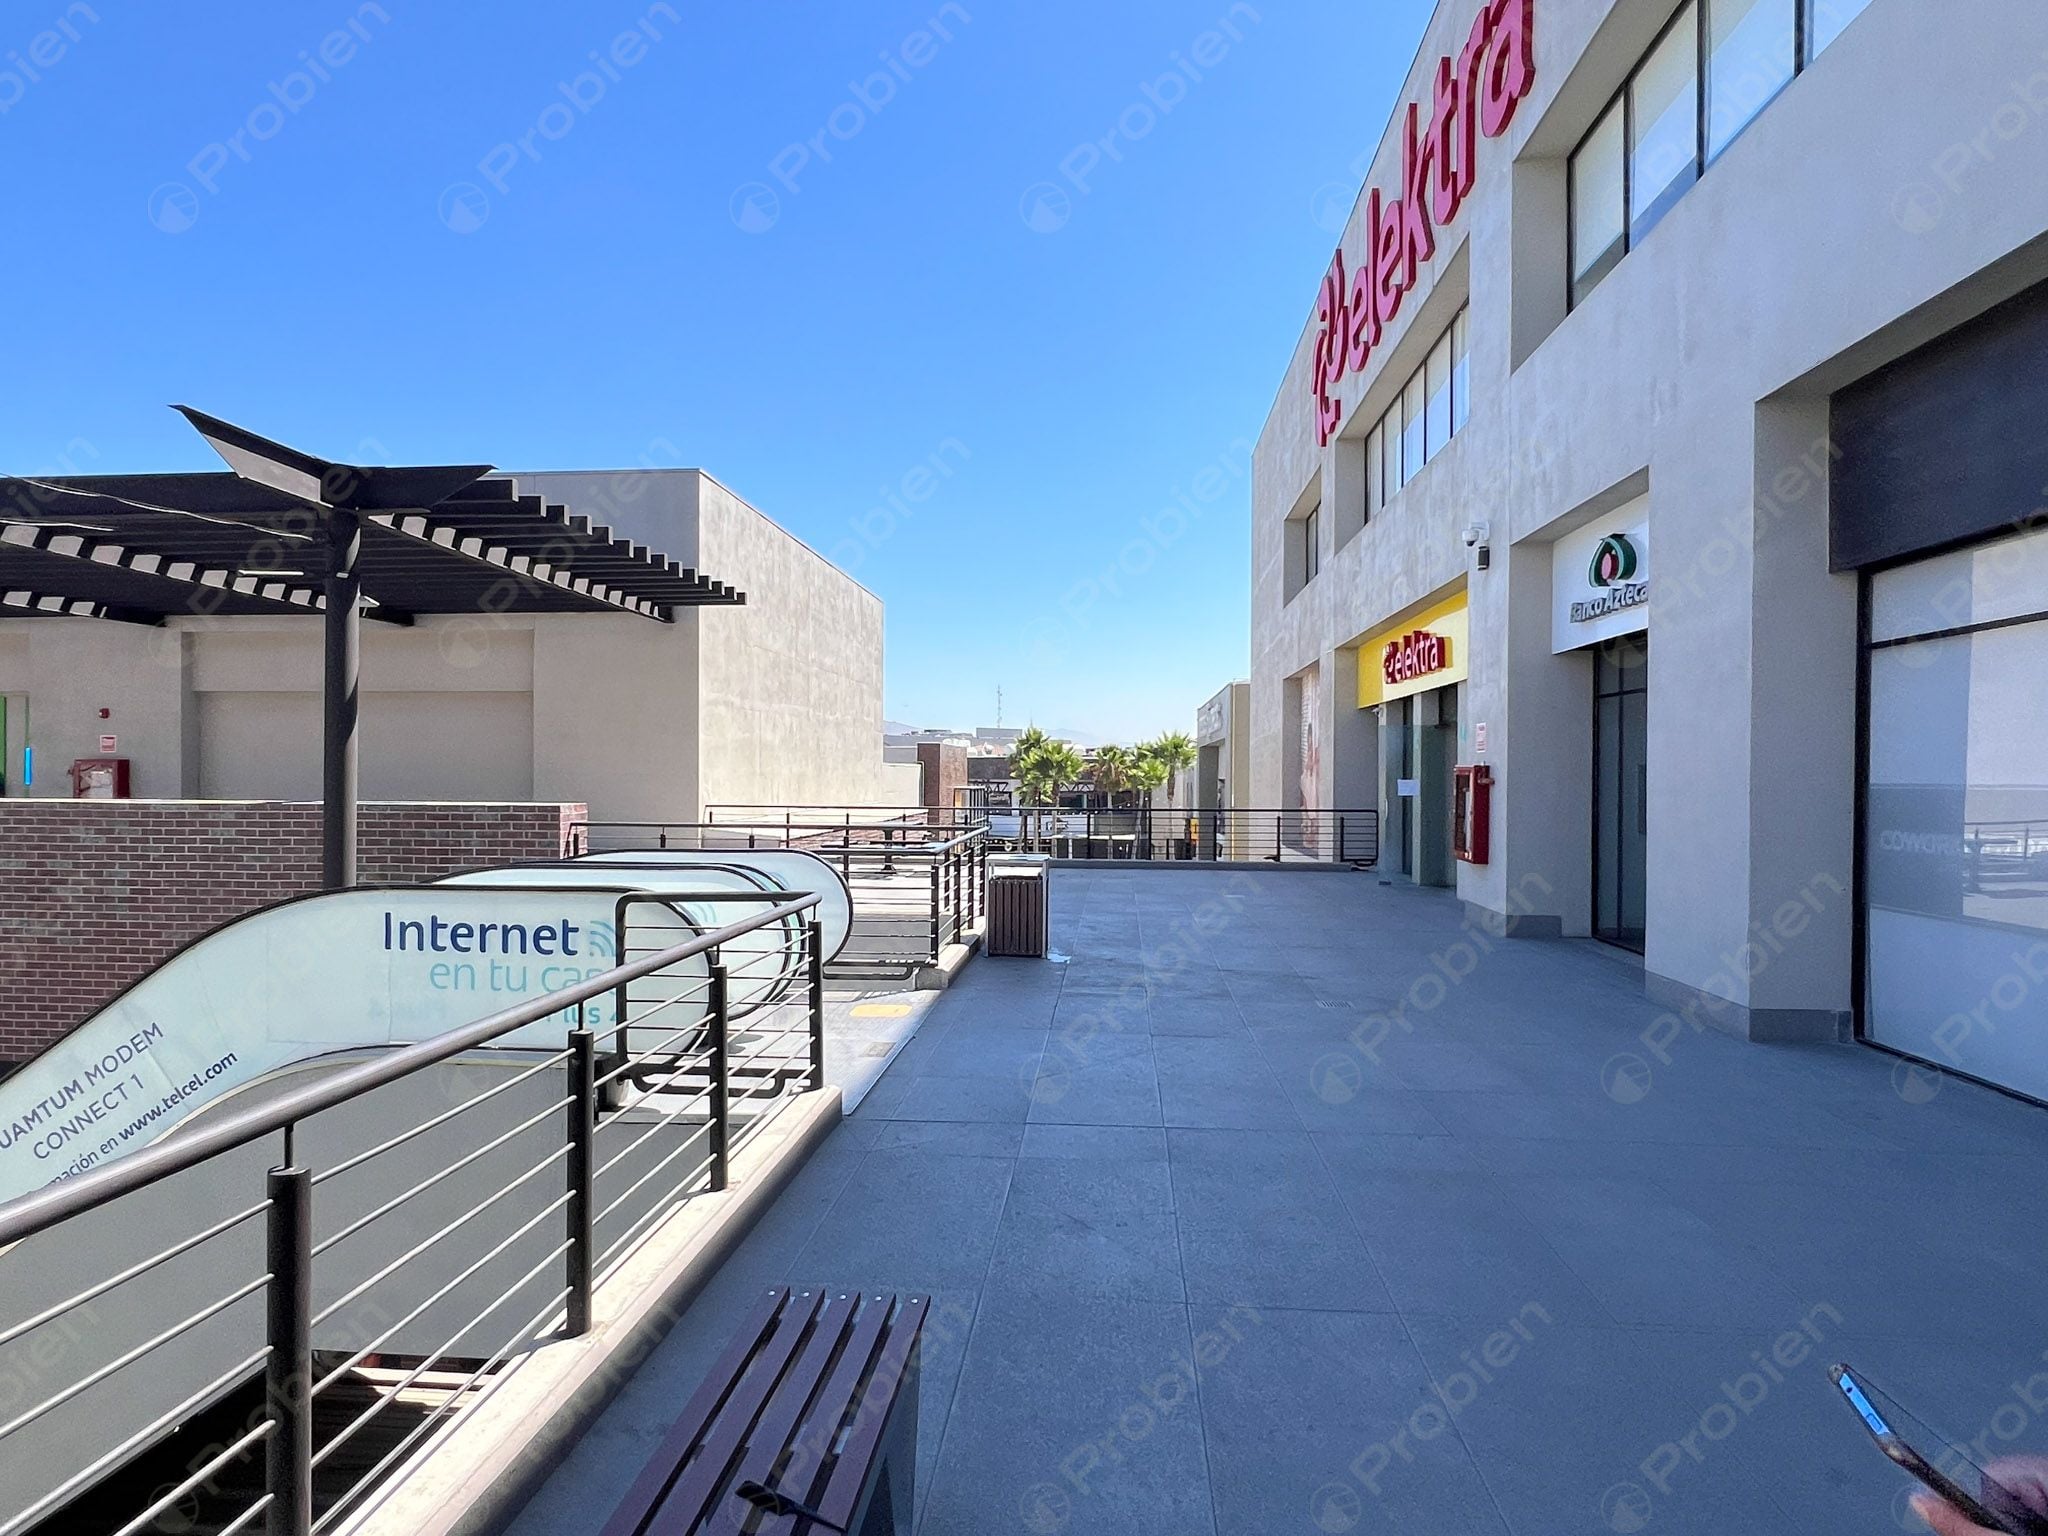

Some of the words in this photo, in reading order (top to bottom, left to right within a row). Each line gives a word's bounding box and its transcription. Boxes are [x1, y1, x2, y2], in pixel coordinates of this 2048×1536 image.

[1349, 0, 1535, 372] elektra
[1604, 581, 1648, 613] Azteca
[1394, 630, 1445, 681] elektra
[384, 912, 579, 955] Internet
[429, 961, 475, 991] en
[489, 958, 527, 993] tu
[84, 1022, 164, 1087] MODEM
[33, 1082, 128, 1160] CONNECT
[130, 1074, 144, 1089] 1
[100, 1137, 119, 1155] en
[119, 1052, 238, 1141] www.telcel.com
